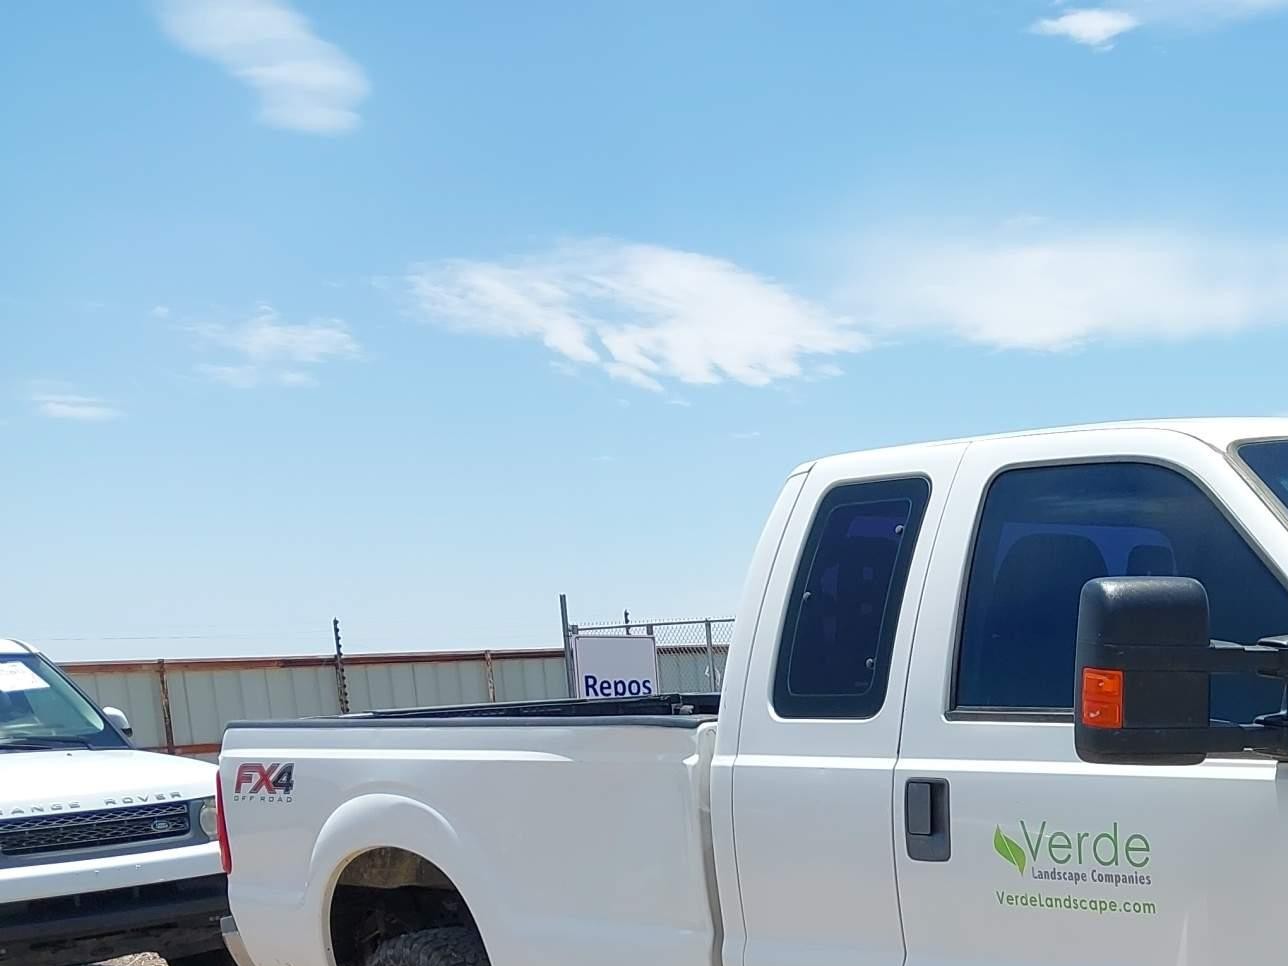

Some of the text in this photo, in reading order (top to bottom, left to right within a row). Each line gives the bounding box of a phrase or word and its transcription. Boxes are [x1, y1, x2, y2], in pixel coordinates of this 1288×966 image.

[584, 674, 652, 697] Repos
[234, 762, 295, 795] FX4
[0, 791, 183, 816] ANGE ROVER
[260, 795, 293, 803] ROAD
[1019, 819, 1151, 868] Verde
[1031, 866, 1152, 887] Landscape Companies
[996, 890, 1157, 914] VerdeLandscape.com
